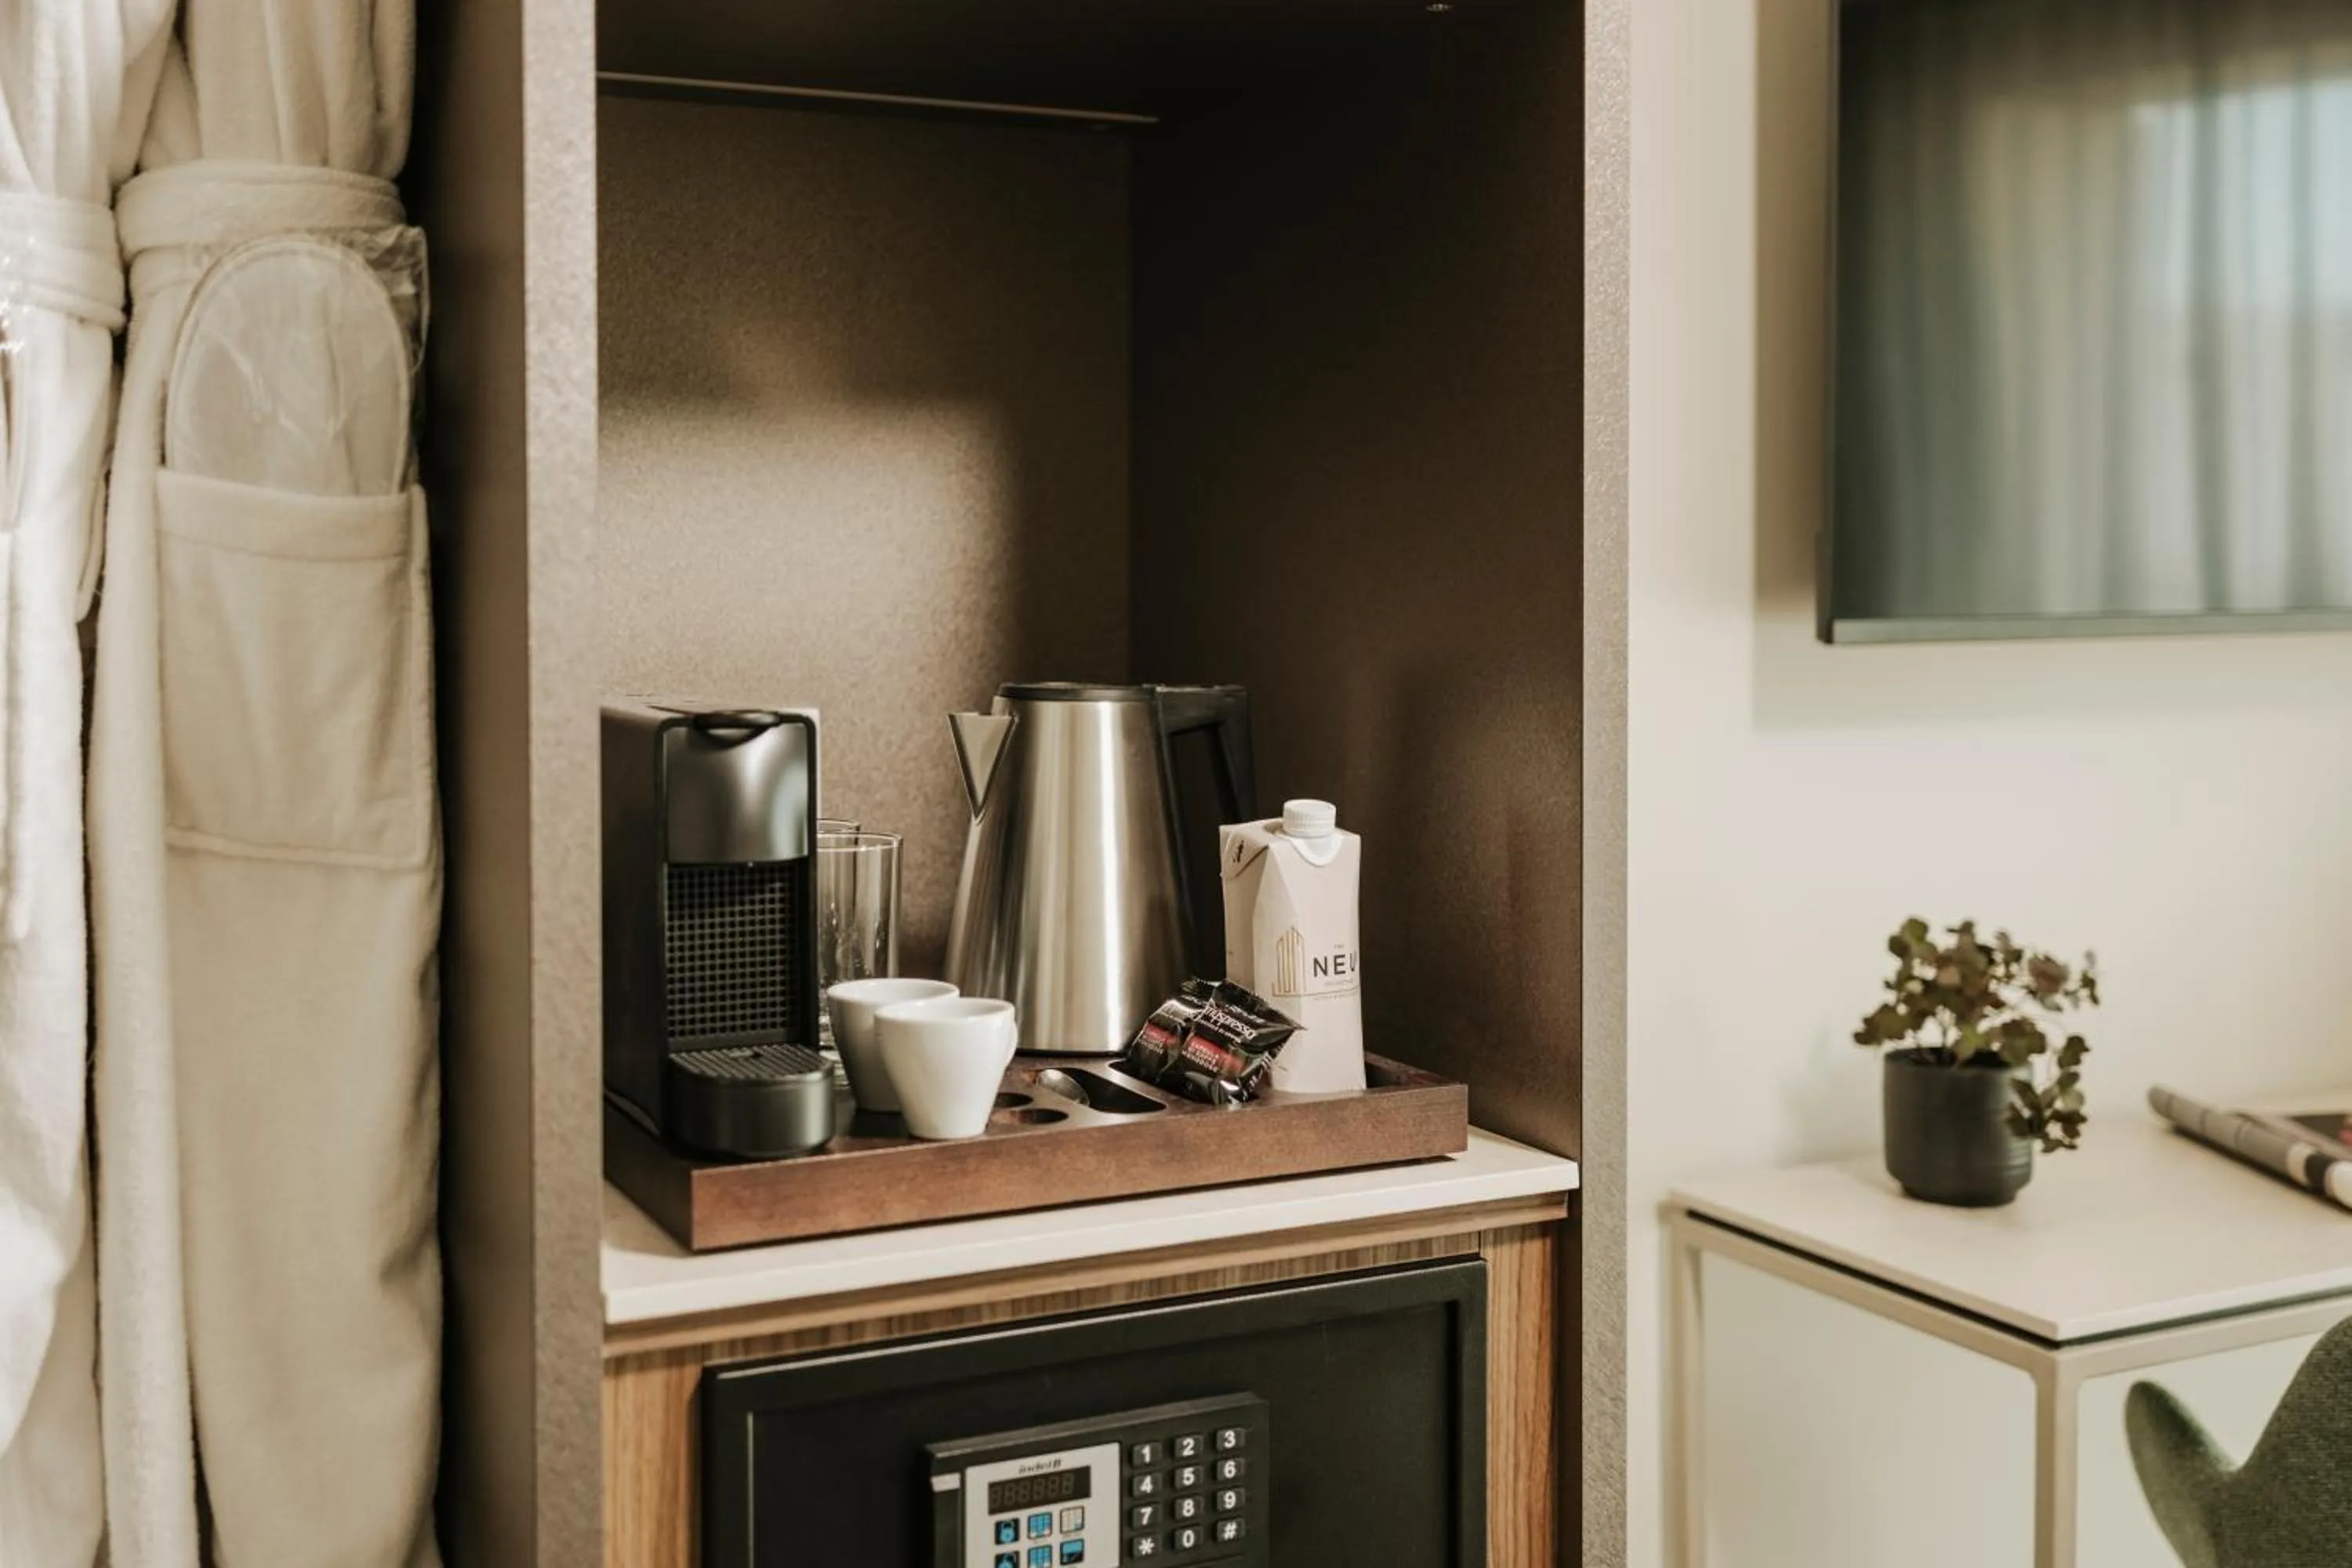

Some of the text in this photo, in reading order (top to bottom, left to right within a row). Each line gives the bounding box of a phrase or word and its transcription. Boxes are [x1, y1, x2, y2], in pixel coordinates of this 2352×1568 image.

[1142, 1430, 1236, 1464] 1 2 3
[1140, 1461, 1236, 1494] 4 5 6
[1140, 1491, 1236, 1526] 7 8 9
[1182, 1530, 1195, 1548] 0
